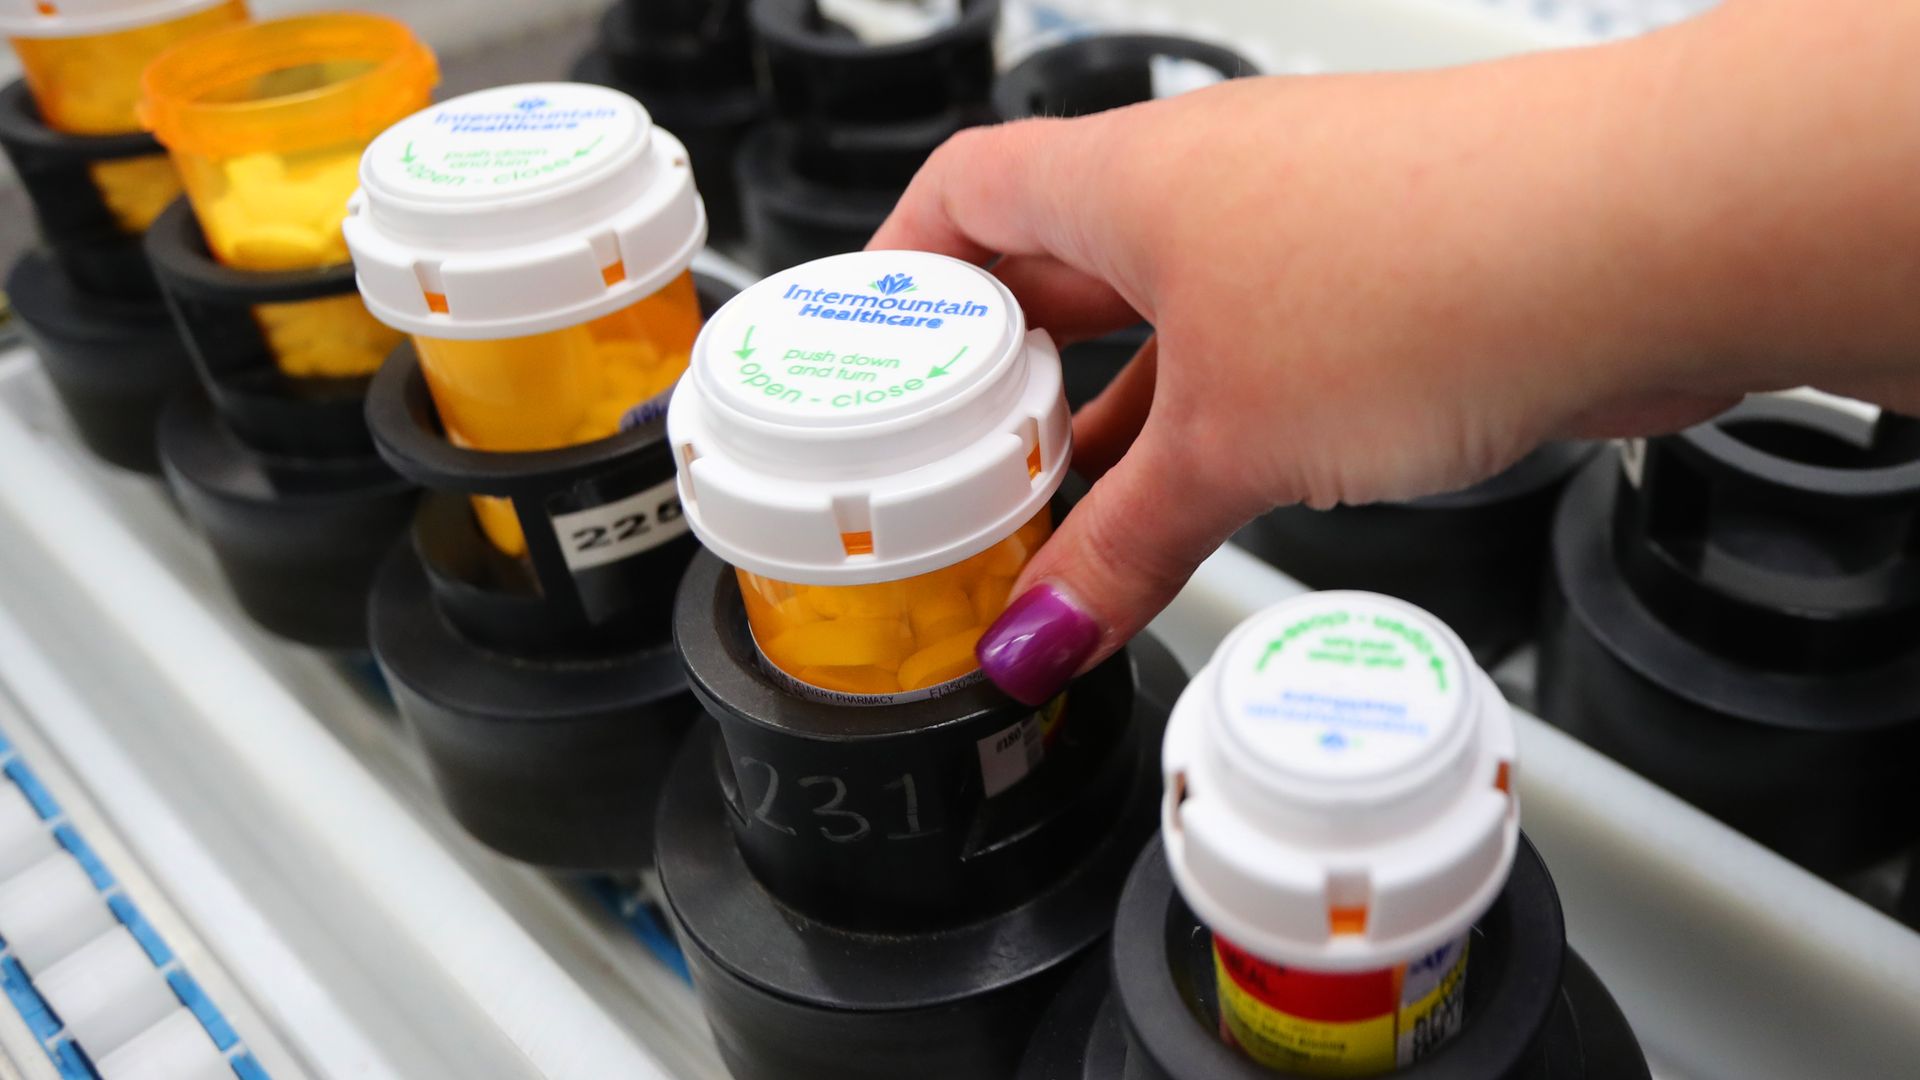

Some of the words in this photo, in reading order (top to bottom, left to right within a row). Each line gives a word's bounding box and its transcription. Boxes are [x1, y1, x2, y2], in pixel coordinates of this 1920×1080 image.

[450, 121, 579, 133] Healthcare
[783, 284, 989, 318] Intermountain
[798, 303, 945, 329] Healthcare
[783, 349, 836, 362] push
[840, 353, 900, 369] down
[739, 362, 803, 404] open
[832, 378, 924, 407] close
[787, 364, 835, 378] and
[836, 368, 877, 382] turn
[836, 693, 894, 705] PHARMACY
[738, 755, 943, 843] 231
